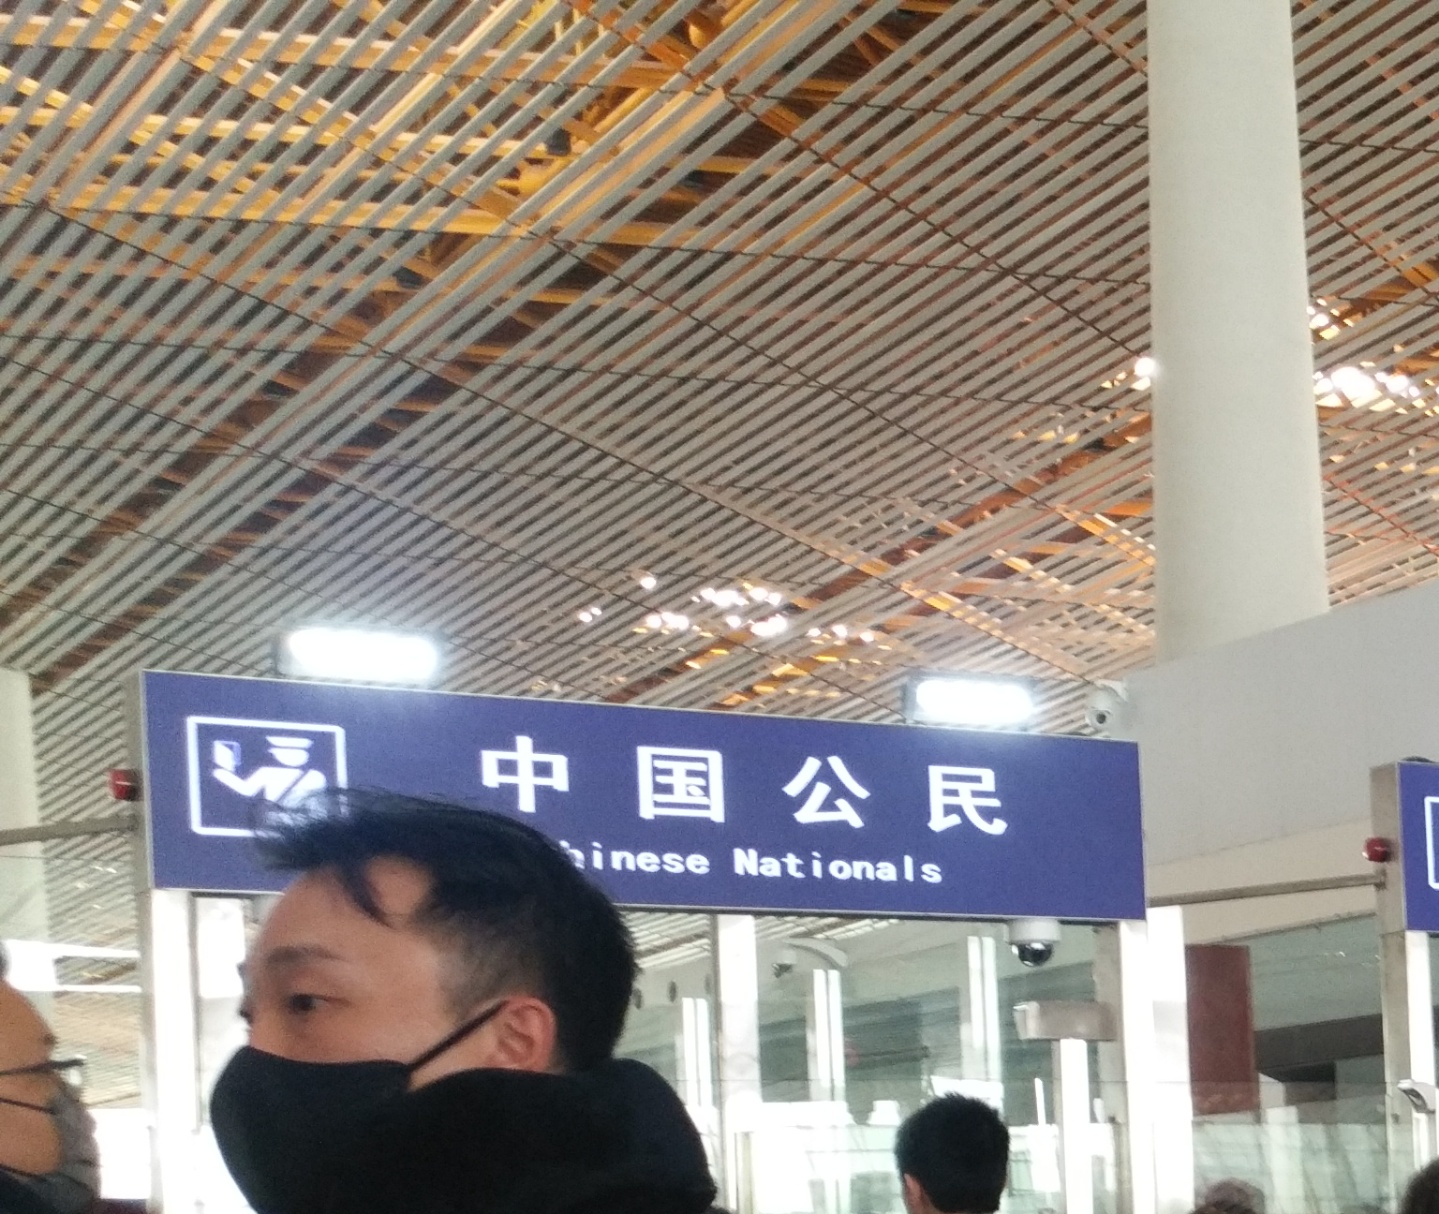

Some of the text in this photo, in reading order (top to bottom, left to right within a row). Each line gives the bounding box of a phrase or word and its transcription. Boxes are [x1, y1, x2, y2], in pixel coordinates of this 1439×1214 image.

[480, 734, 1008, 836] 中国公民
[557, 840, 943, 884] hinese Nationals
